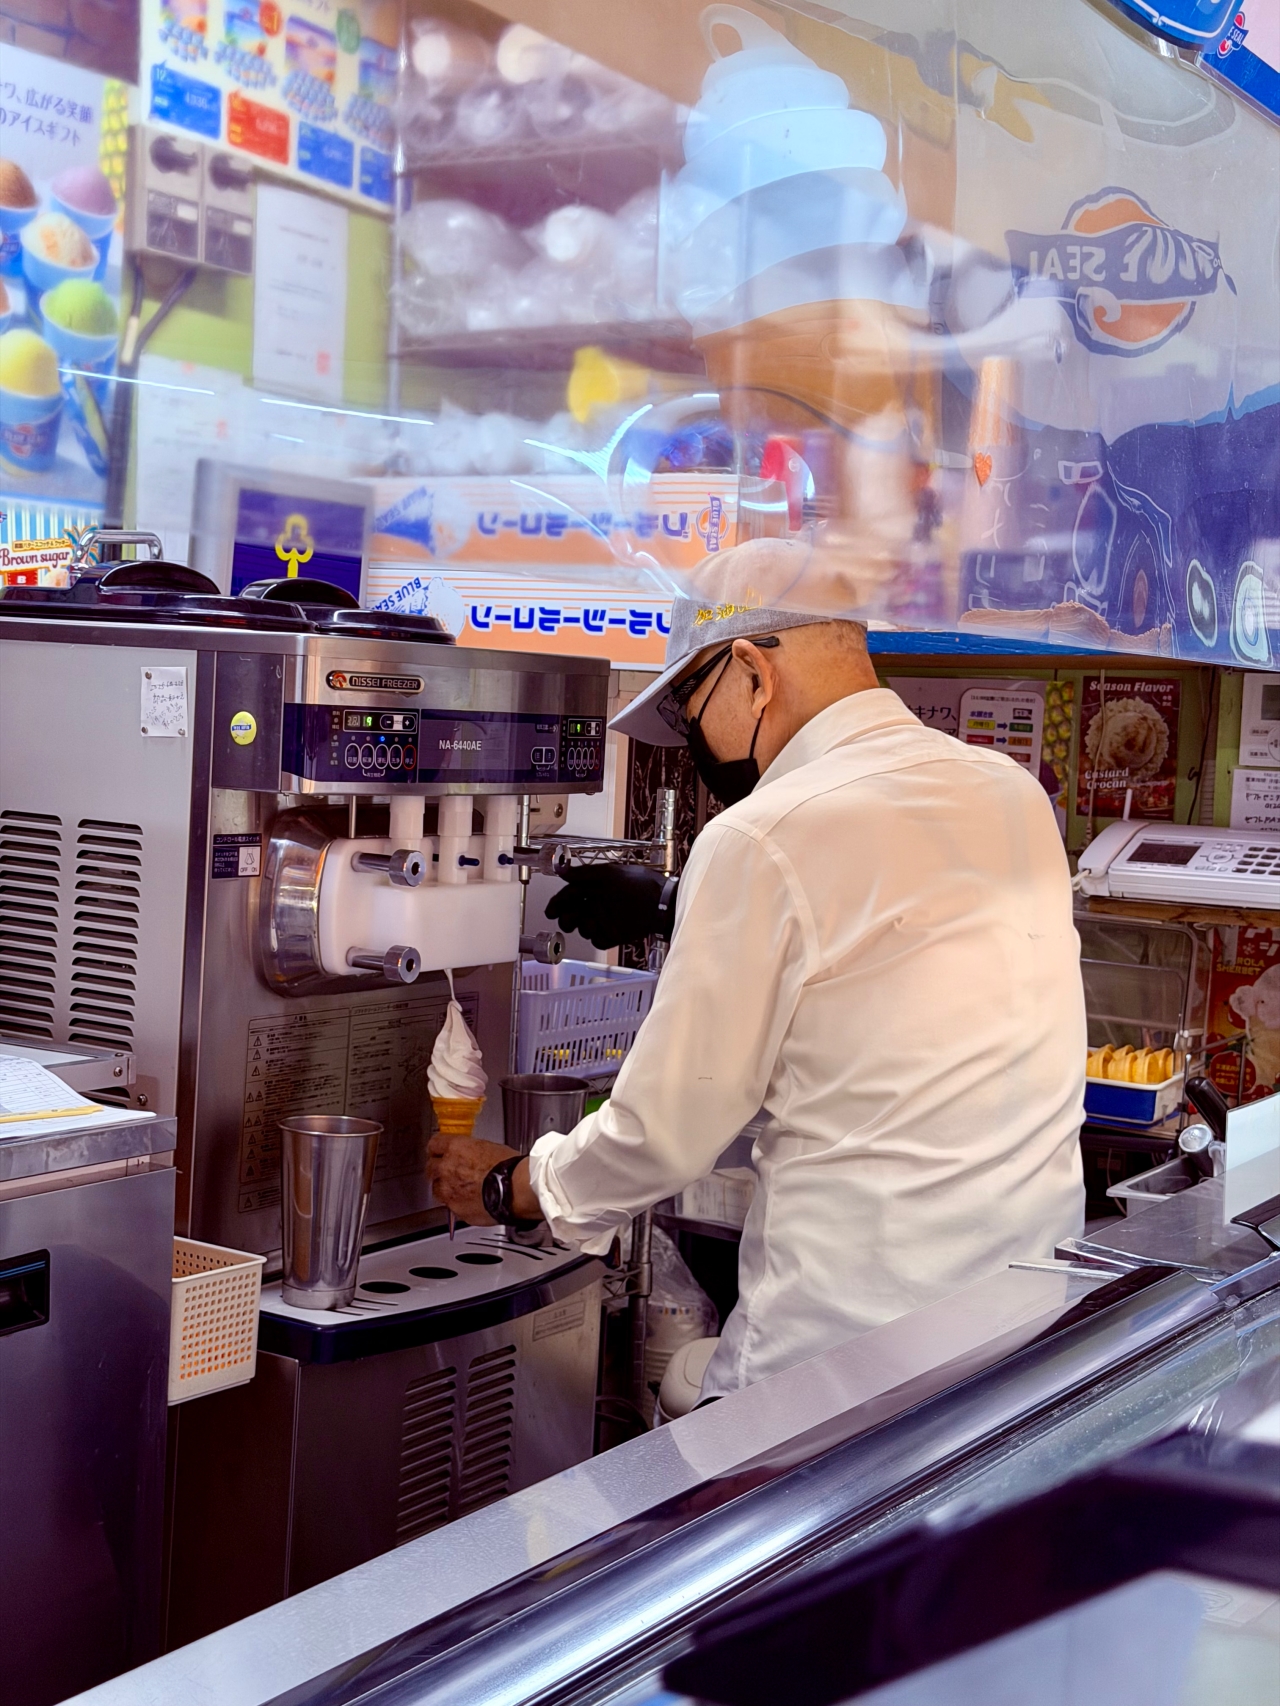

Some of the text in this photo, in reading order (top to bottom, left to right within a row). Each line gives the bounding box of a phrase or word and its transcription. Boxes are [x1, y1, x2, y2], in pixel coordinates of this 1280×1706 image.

[0, 548, 70, 568] Brown sugar
[374, 577, 422, 611] BLUE SEA
[352, 677, 418, 689] NISSEI FREEZER
[1133, 682, 1174, 693] Flavor
[439, 739, 482, 751] NA-6440AE
[1084, 767, 1130, 780] Custard
[1086, 780, 1127, 790] Crocan
